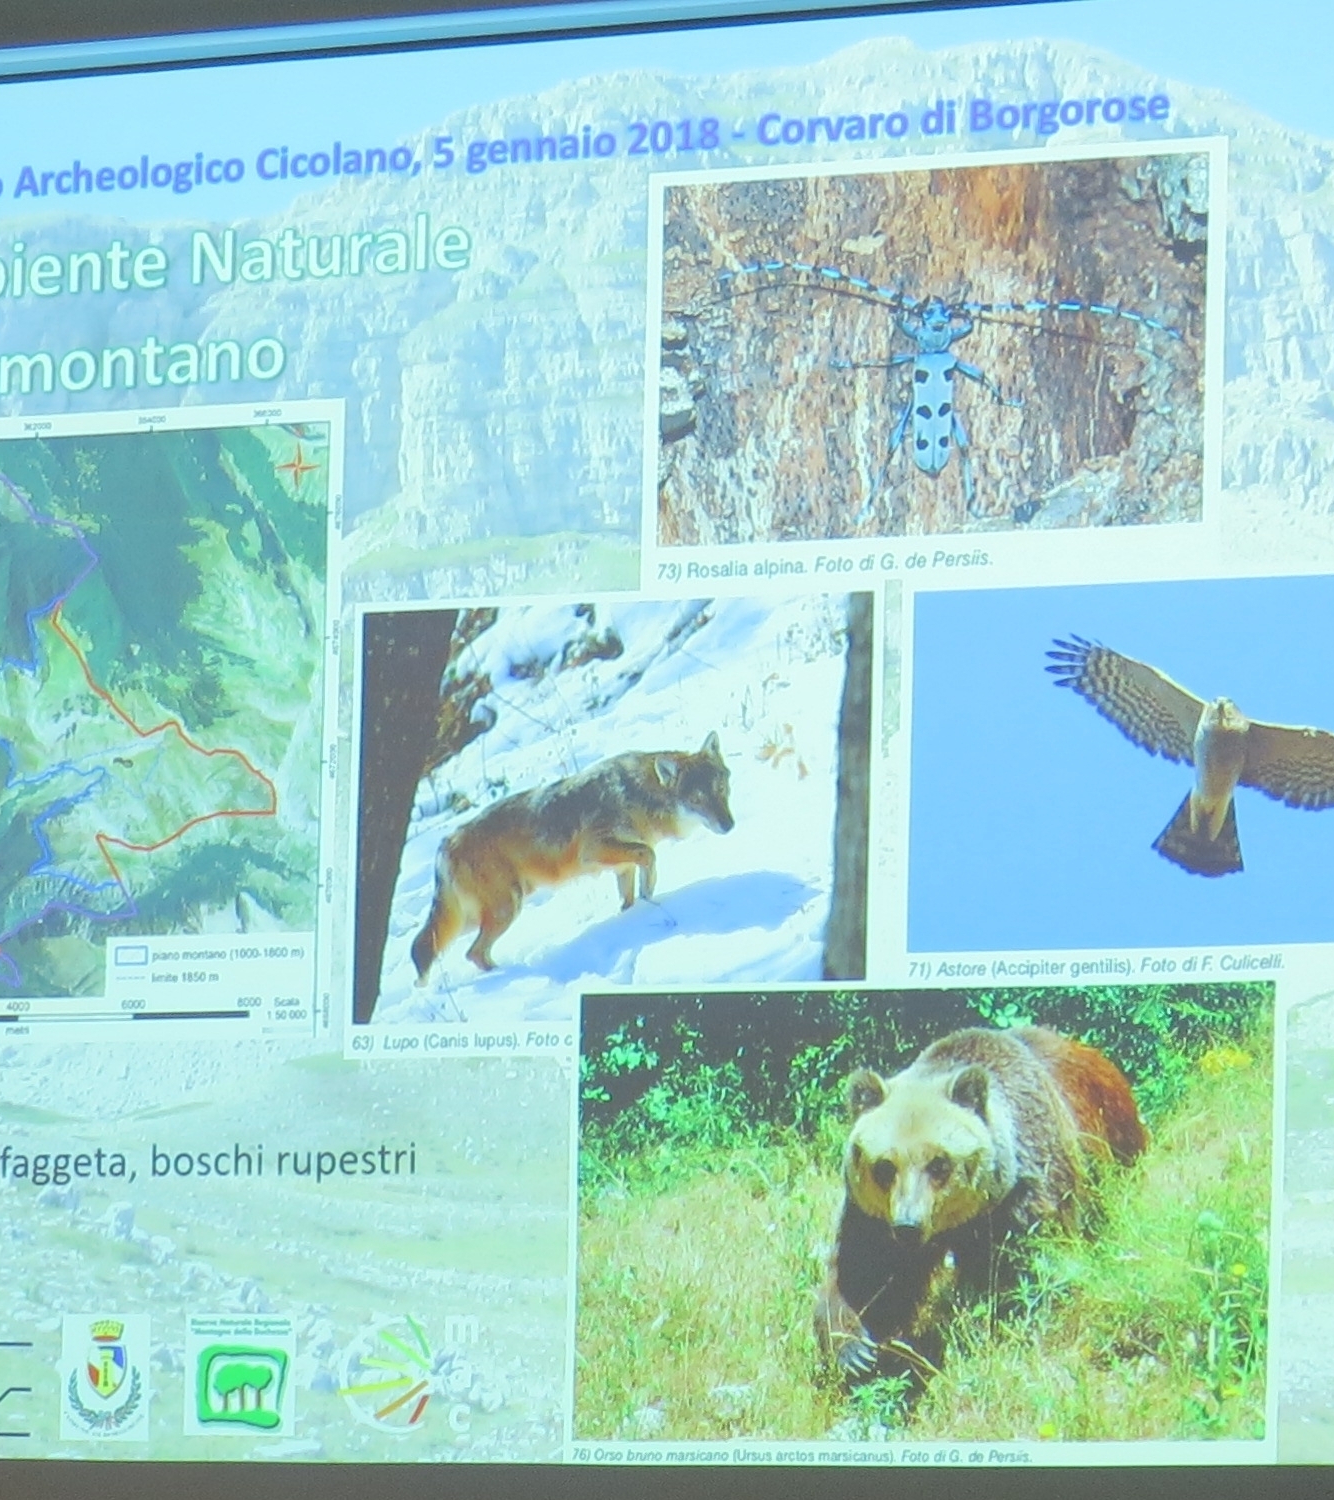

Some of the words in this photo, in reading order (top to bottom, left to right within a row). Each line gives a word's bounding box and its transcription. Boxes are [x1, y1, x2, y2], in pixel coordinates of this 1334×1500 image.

[14, 152, 245, 199] Archeologico
[256, 140, 422, 181] Cicolano,
[434, 136, 453, 166] 5
[467, 125, 617, 175] gennaio
[627, 117, 719, 157] 2018
[756, 110, 910, 148] Corvaro
[921, 100, 957, 140] di
[970, 93, 1170, 137] Borgorose
[190, 213, 473, 287] Naturale
[657, 562, 682, 584] 73)
[686, 560, 749, 579] Rosalia
[753, 558, 808, 580] alpina.
[814, 555, 854, 573] Foto
[858, 553, 876, 571] di
[879, 552, 899, 571] G.
[904, 551, 927, 570] de
[931, 548, 994, 568] Persiis.
[151, 950, 180, 963] piano
[181, 949, 227, 961] montano
[908, 961, 932, 981] 71)
[935, 960, 987, 978] Astore
[991, 959, 1066, 979] (Accipiter
[1069, 957, 1136, 979] gentilis).
[1140, 956, 1177, 974] Foto
[1181, 955, 1198, 973] di
[1200, 955, 1213, 972] F.
[1219, 953, 1285, 971] Culicelli.
[151, 972, 178, 984] limite
[181, 971, 207, 983] 1850
[208, 973, 220, 983] m
[5, 1001, 31, 1012] 4000
[120, 999, 147, 1010] 6000
[236, 996, 263, 1008] 8000
[351, 1035, 375, 1054] 63)
[383, 1034, 420, 1053] Lupo
[423, 1032, 469, 1052] (Canis
[474, 1032, 521, 1051] lupus).
[525, 1031, 560, 1048] Foto
[150, 1142, 264, 1177] boschi
[277, 1141, 417, 1184] rupestri
[593, 1447, 624, 1462] Orso
[626, 1448, 663, 1462] bruno
[665, 1449, 730, 1462] marsicano
[900, 1449, 930, 1463] Foto
[933, 1449, 946, 1463] di
